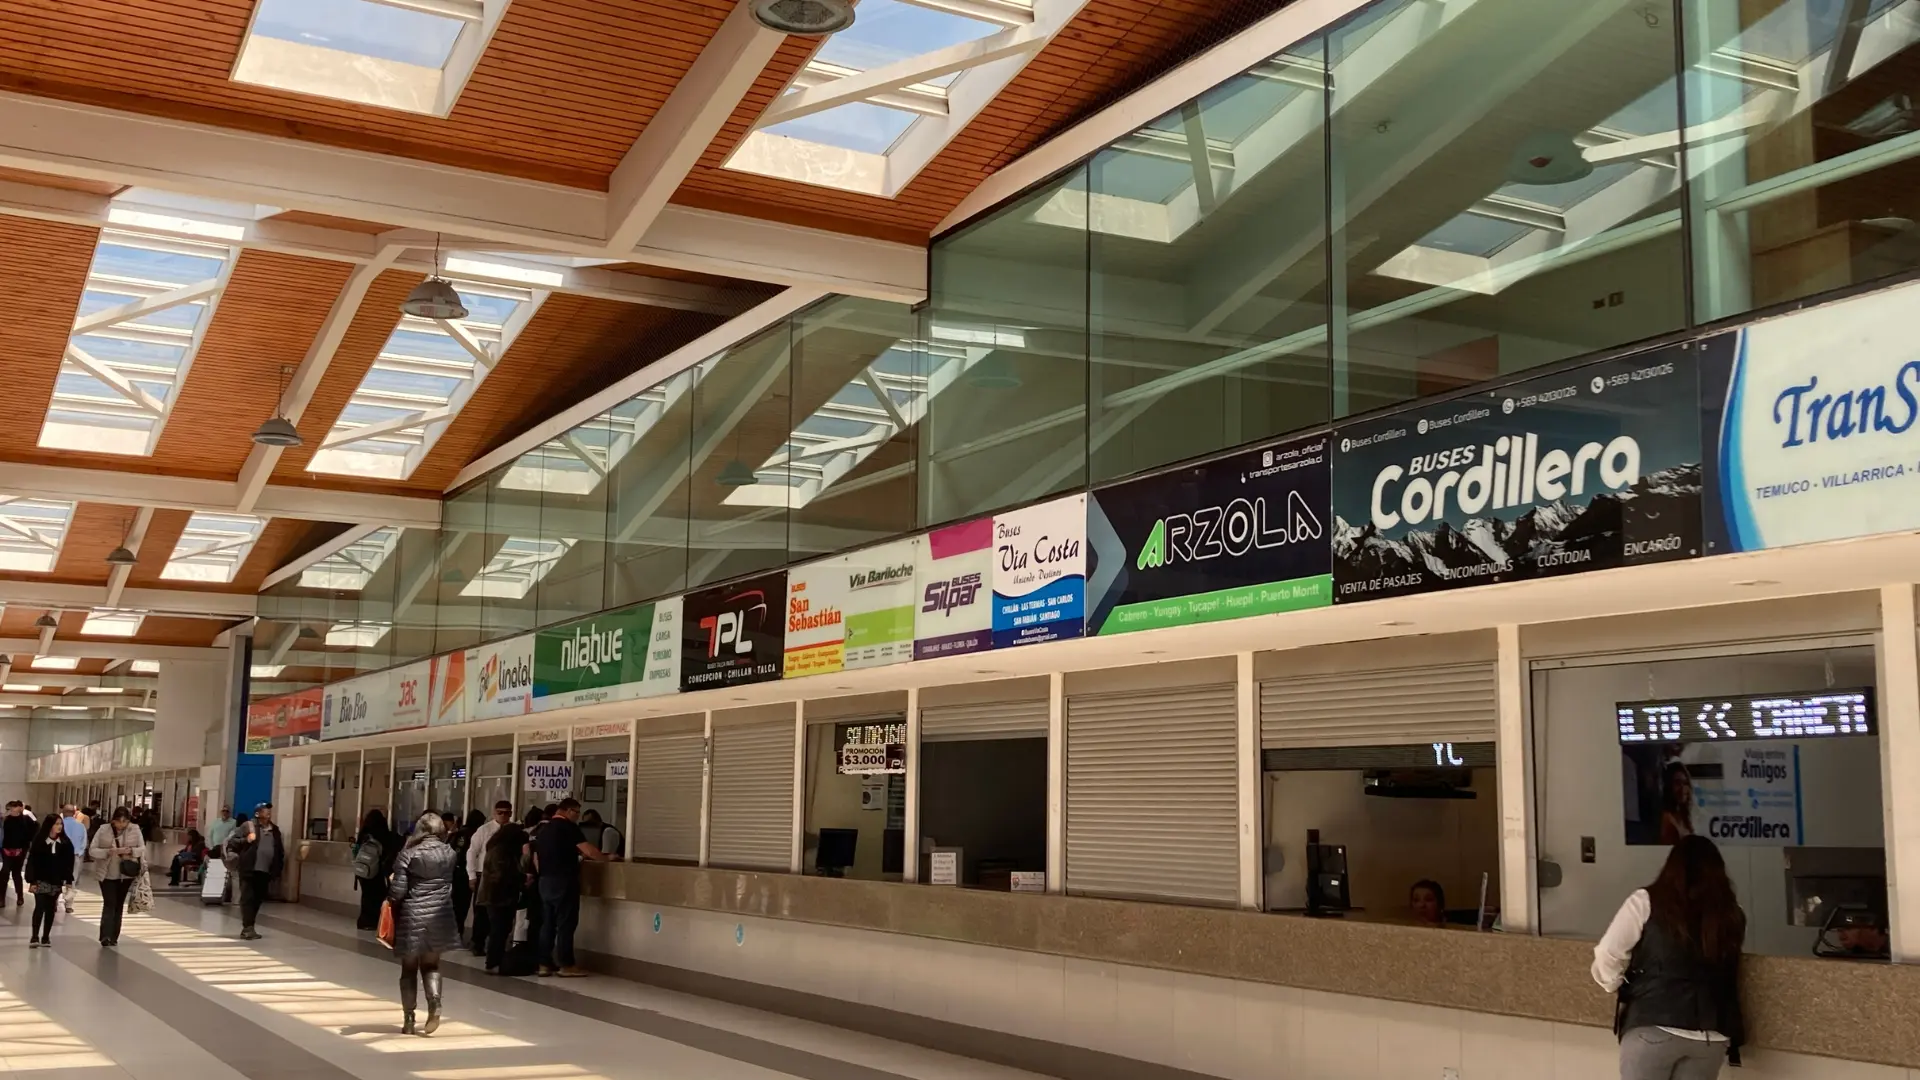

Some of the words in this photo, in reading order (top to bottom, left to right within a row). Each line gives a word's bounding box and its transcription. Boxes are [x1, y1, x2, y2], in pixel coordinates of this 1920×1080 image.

[1429, 416, 1452, 430] Buses
[1453, 408, 1490, 424] Cordillera
[1351, 437, 1371, 449] Buses
[1373, 428, 1407, 444] Cordillera
[1409, 445, 1476, 476] BUSES
[1371, 432, 1641, 530] Cordillera
[1756, 479, 1810, 500] TEMUCO
[1822, 464, 1905, 489] VILLARRICA
[997, 523, 1021, 539] Buses
[1137, 490, 1322, 570] ARZOLA
[1034, 536, 1079, 564] Costa
[867, 564, 913, 583] Bariloche
[1340, 581, 1367, 595] VENTA
[1369, 578, 1382, 591] DE
[1383, 573, 1422, 589] PASAJES
[1443, 560, 1514, 580] ENCOMIENDAS
[1537, 549, 1591, 567] CUSTODIA
[1624, 536, 1681, 556] ENCARGO
[952, 572, 981, 587] BUSES
[790, 597, 809, 614] San
[922, 580, 982, 617] Silpar
[1119, 609, 1147, 622] Cabrero
[1154, 605, 1181, 618] Yungay
[1188, 599, 1220, 612] Tucapel
[1261, 588, 1291, 602] Puerto
[1293, 583, 1319, 597] Montt
[789, 605, 841, 632] Sebastián
[688, 672, 722, 684] CONCEPCION
[727, 667, 752, 678] CHILLAN
[757, 663, 776, 674] TALCA
[527, 765, 572, 777] CHILLAN
[844, 755, 885, 766] $3.000
[1741, 759, 1787, 783] Amigos
[540, 779, 568, 789] 3.000
[1709, 816, 1790, 838] Cordillera
